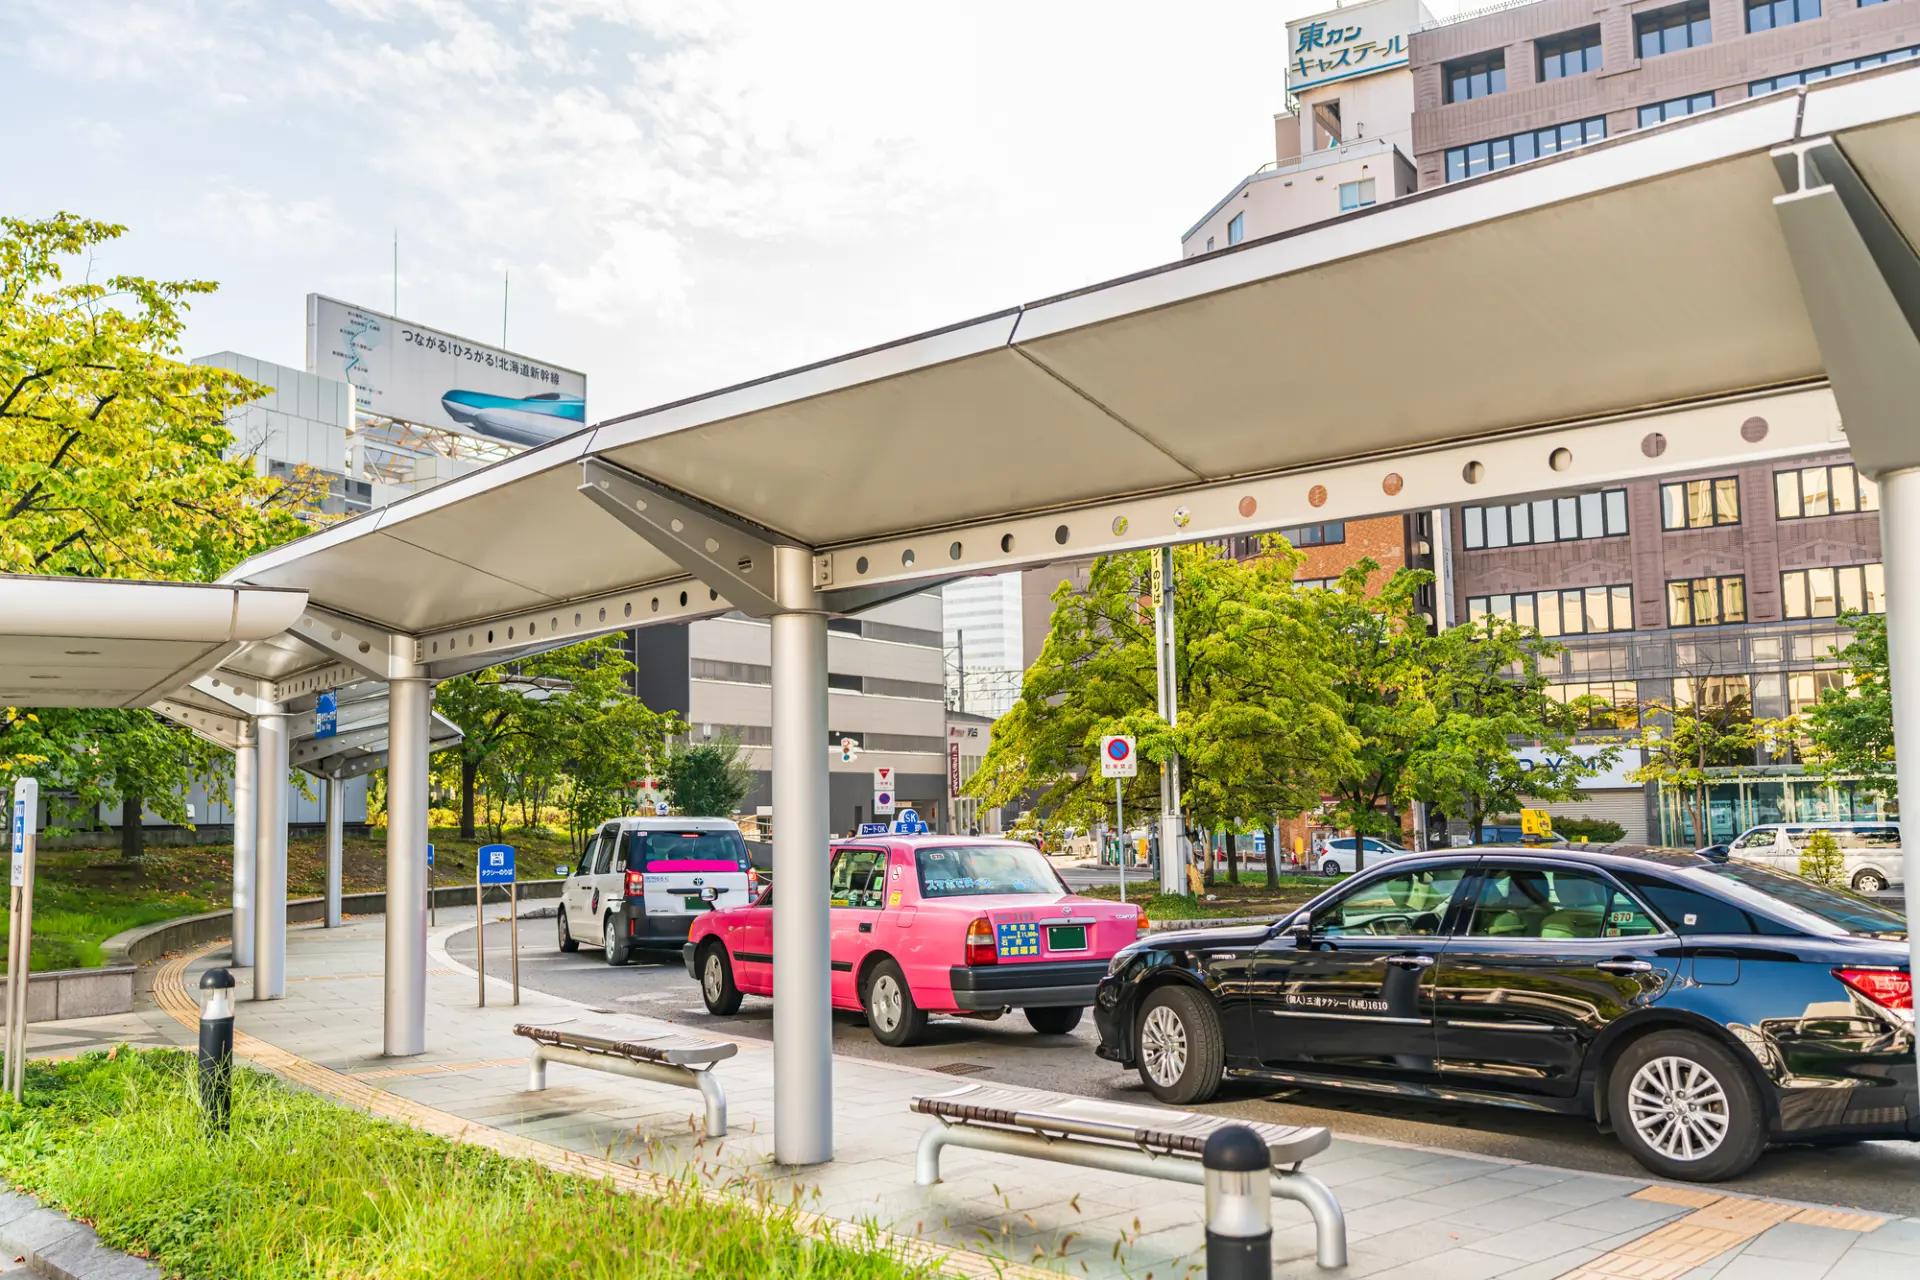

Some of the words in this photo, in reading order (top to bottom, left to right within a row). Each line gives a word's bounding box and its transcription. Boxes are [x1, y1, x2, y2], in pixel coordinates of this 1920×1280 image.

[1296, 22, 1362, 54] 東カン
[1292, 35, 1408, 77] キャステール
[905, 813, 916, 822] SK
[1613, 913, 1631, 921] 670
